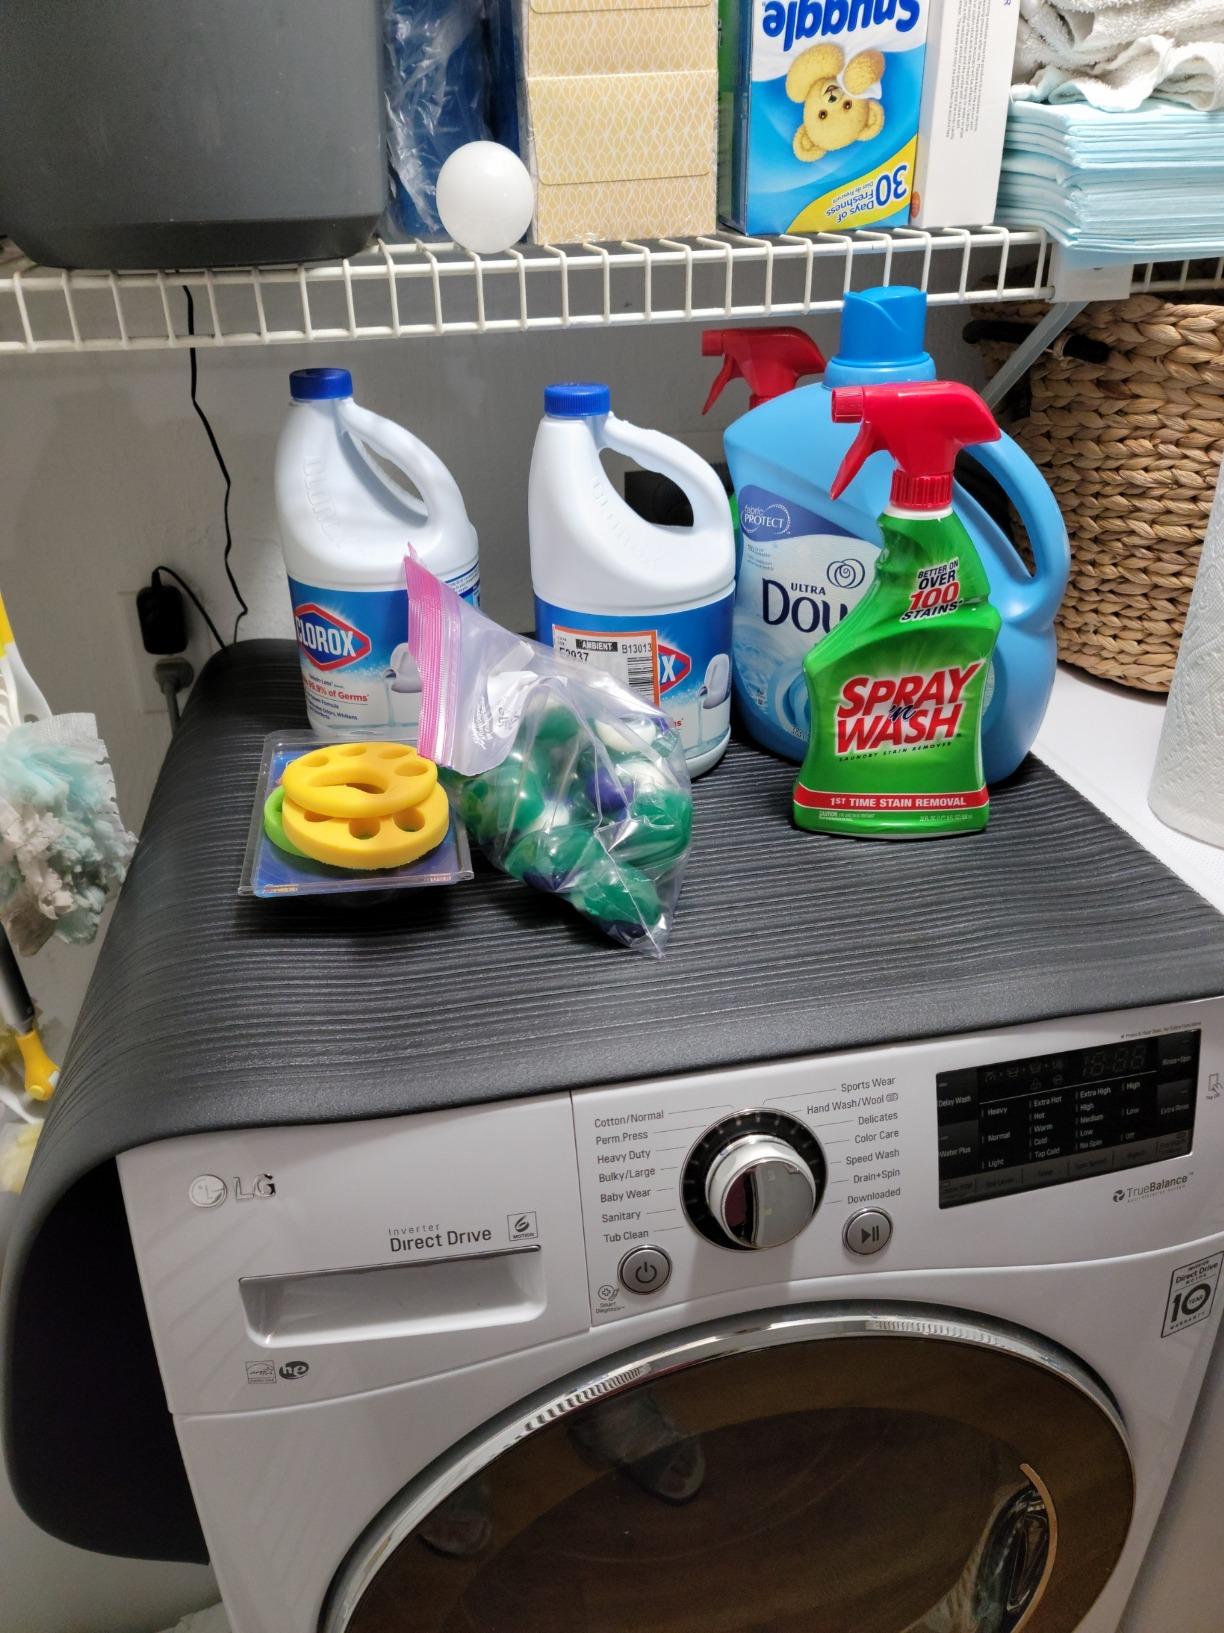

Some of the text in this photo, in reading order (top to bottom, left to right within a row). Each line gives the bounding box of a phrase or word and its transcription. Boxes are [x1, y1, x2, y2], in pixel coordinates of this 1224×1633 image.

[762, 0, 920, 52] Snuggle
[876, 164, 907, 206] 30
[826, 190, 874, 216] Freshness
[837, 200, 874, 223] Days of
[745, 514, 784, 528] PROTECT
[918, 559, 958, 578] BETTER ON
[919, 570, 956, 590] OVER
[791, 582, 826, 596] ULTRA
[911, 581, 960, 610] 100
[581, 642, 653, 654] AMBIENT B13013
[328, 689, 336, 697] of
[338, 692, 368, 702] Germs
[836, 662, 985, 719] SPRAY
[836, 704, 963, 754] WASH
[830, 797, 966, 807] 1ST TIME STAIN REMOVAL
[841, 1077, 896, 1093] Sports Wear
[1080, 1086, 1111, 1098] Extra High
[1127, 1081, 1141, 1090] High
[807, 1103, 830, 1114] Hand
[832, 1094, 884, 1111] Wash/Wool
[1034, 1098, 1050, 1107] Extra
[1080, 1103, 1094, 1112] High
[988, 1106, 1008, 1117] Heavy
[1034, 1112, 1045, 1120] Hot
[1126, 1107, 1140, 1115] Low
[594, 1110, 664, 1128] Cotton/Normal
[858, 1112, 898, 1125] Delicates
[1034, 1124, 1053, 1133] Warm
[1080, 1129, 1093, 1137] Low
[596, 1132, 648, 1145] Perm Press
[855, 1130, 899, 1144] Color Care
[988, 1131, 1011, 1142] Normal
[1034, 1137, 1048, 1146] Cold
[597, 1150, 651, 1164] Heavy Duty
[846, 1148, 900, 1166] Speed Wash
[1047, 1147, 1060, 1156] Cold
[988, 1158, 1005, 1168] Light
[599, 1168, 656, 1182] Bulky/Large
[853, 1168, 900, 1183] Drain+Spin
[233, 1173, 276, 1200] LG
[1127, 1175, 1188, 1198] TrueBalance
[600, 1189, 652, 1203] Baby Wear
[847, 1187, 901, 1204] Downloaded
[602, 1212, 641, 1223] Sanitary
[388, 1224, 439, 1236] Inverter
[603, 1230, 649, 1243] Tub Clean
[390, 1229, 492, 1252] Direct Drive
[1175, 1270, 1198, 1283] Direct
[1199, 1263, 1218, 1275] Drive
[1171, 1283, 1211, 1323] 10
